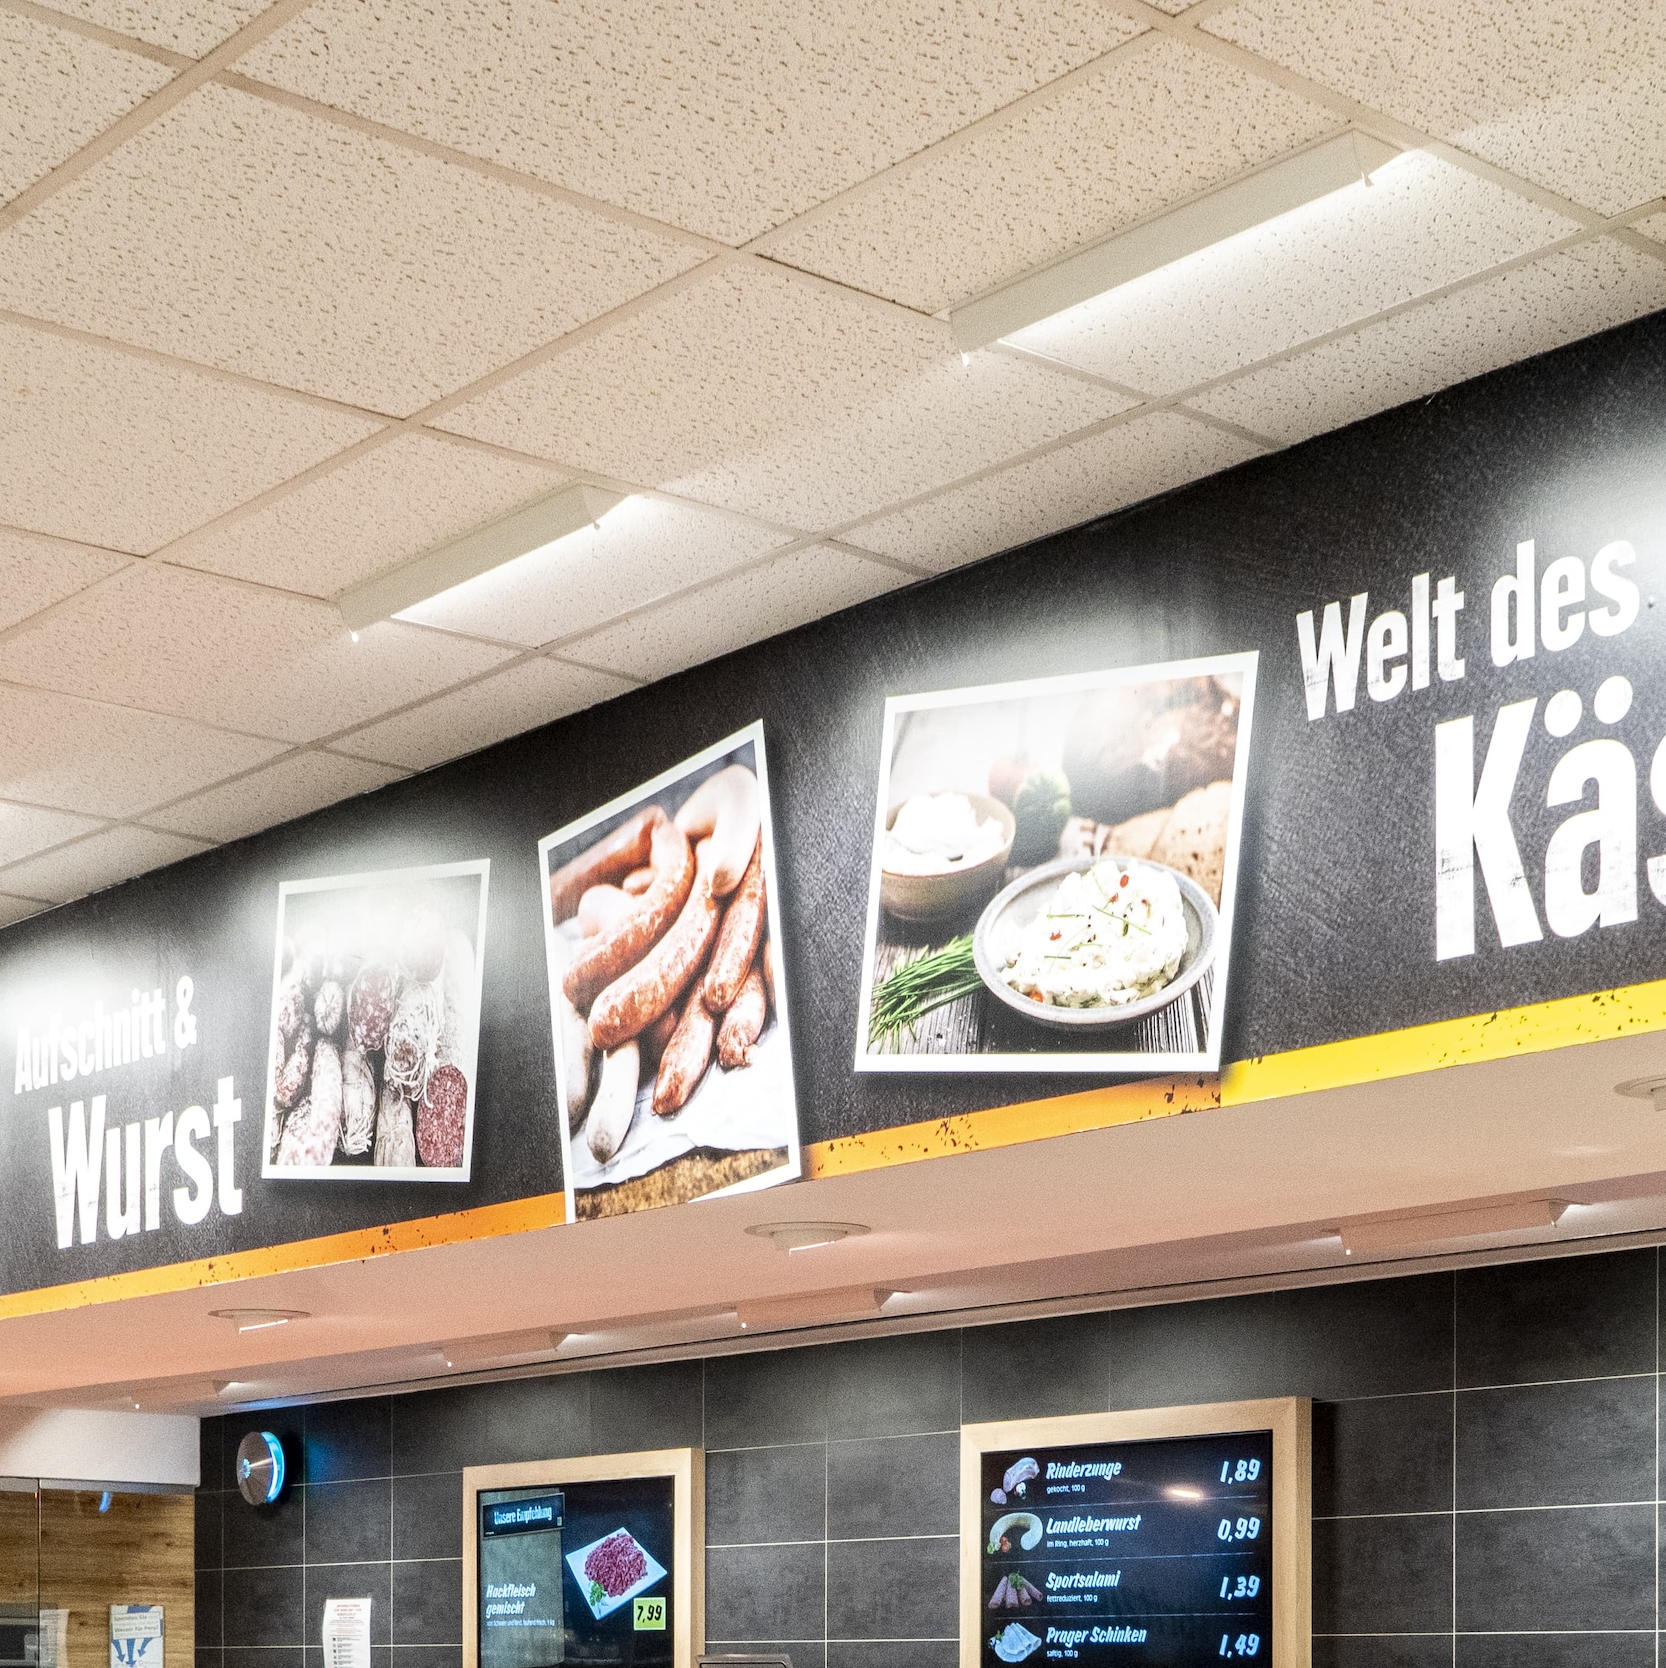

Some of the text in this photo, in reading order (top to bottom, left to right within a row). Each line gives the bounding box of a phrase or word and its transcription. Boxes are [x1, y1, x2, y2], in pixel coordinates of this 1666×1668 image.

[1297, 540, 1640, 721] Welt des
[14, 976, 197, 1094] Aufschnitt &
[48, 1077, 242, 1249] Wurst
[1045, 1459, 1260, 1484] Rinderzunge 1,89
[494, 1510, 516, 1525] Unsere
[1046, 1515, 1261, 1542] Landleberwurst 0,99
[486, 1583, 536, 1598] Hackfleisch
[1045, 1570, 1260, 1600] Sportsalami 1,39
[486, 1602, 662, 1623] gemischt 7,99
[1046, 1627, 1260, 1659] Prager Schinken 1,49
